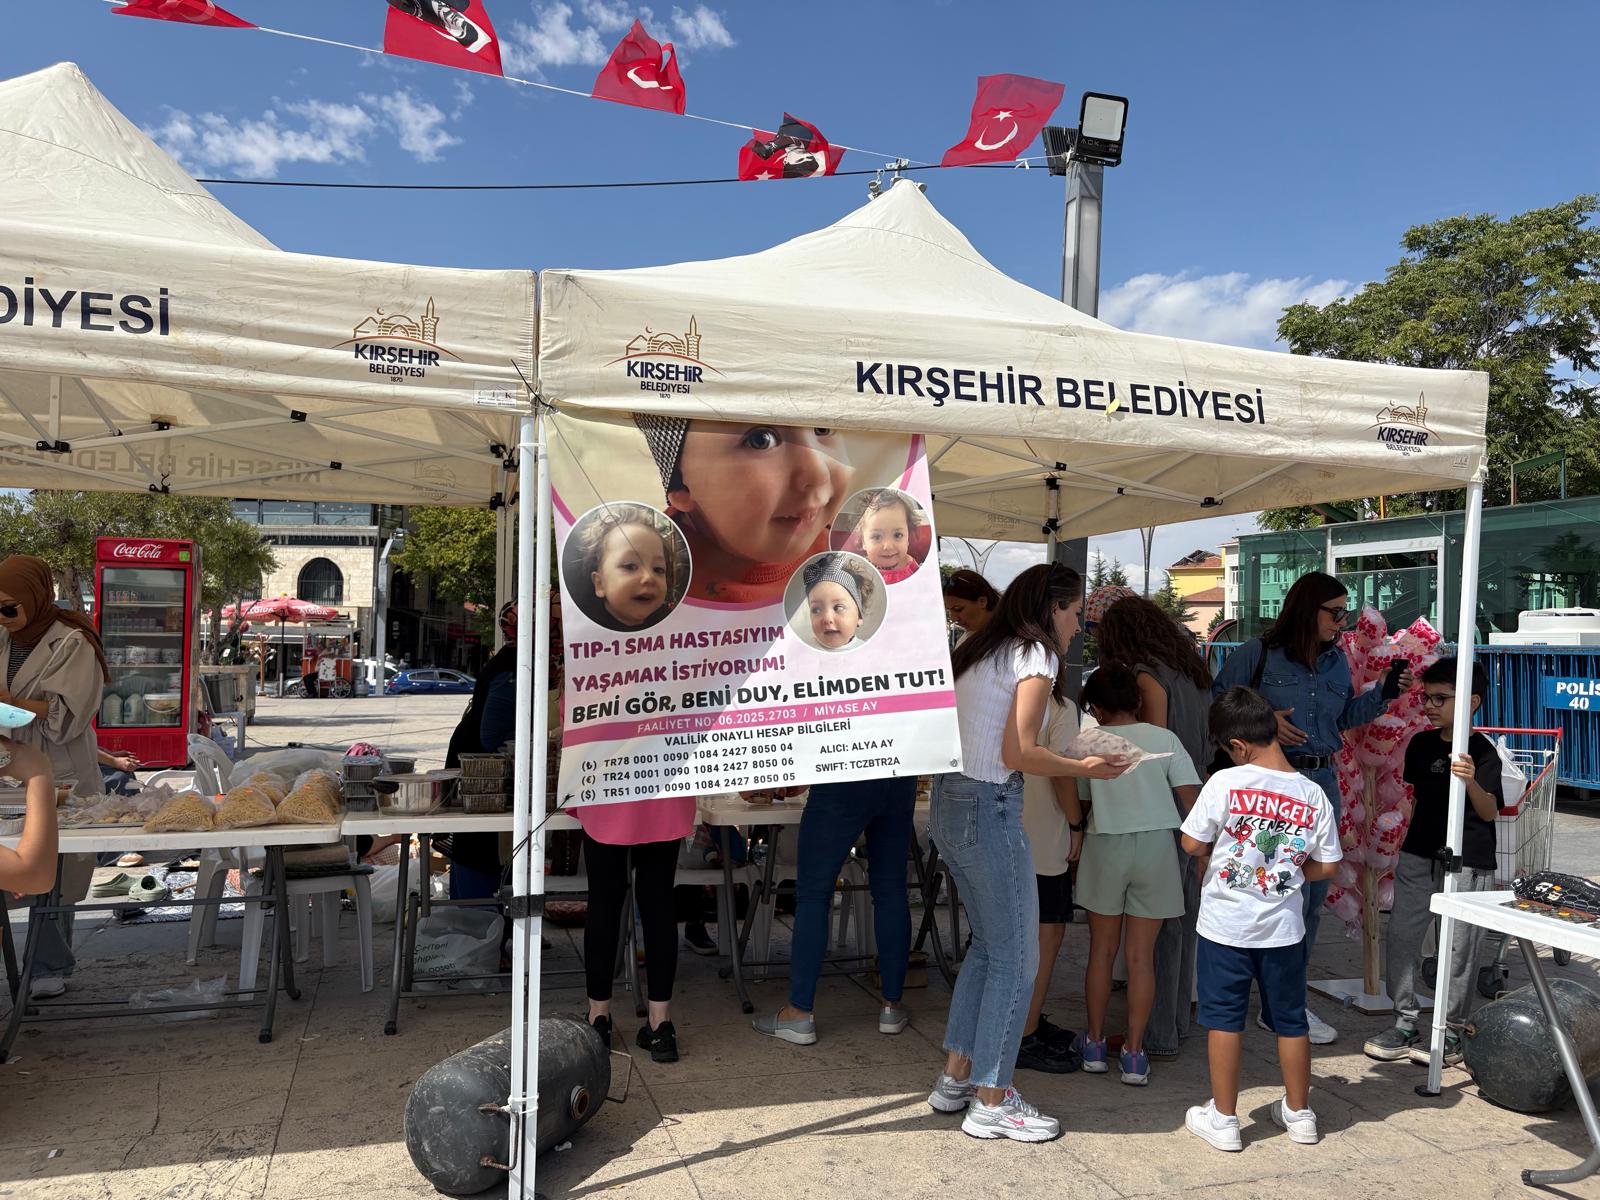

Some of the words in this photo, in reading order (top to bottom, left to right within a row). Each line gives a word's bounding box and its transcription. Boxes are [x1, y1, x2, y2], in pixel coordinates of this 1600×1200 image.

[856, 361, 1046, 408] KIRŞEHİR
[1056, 377, 1266, 425] BELEDİYESİ
[570, 640, 620, 659] TIP-1
[625, 635, 665, 655] SMA
[669, 625, 785, 649] HASTASIYIM
[572, 665, 667, 693] YAŞAMAK
[672, 655, 786, 681] İSTİYORUM!
[572, 695, 620, 724] BENİ
[625, 691, 676, 714] GÖR,
[681, 684, 732, 709] BENİ
[737, 684, 789, 704] DUY,
[793, 675, 890, 699] ELİMDEN
[894, 668, 946, 689] TUT!
[1568, 697, 1590, 710] 40
[637, 716, 690, 734] FAALİYET
[695, 716, 716, 728] NO:
[718, 708, 796, 726] 06.2025.2703
[814, 702, 860, 717] MİYASE
[861, 701, 879, 712] AY
[664, 732, 708, 747] VALİLİK
[712, 729, 753, 743] ONAYLI
[756, 727, 794, 739] HESAP
[797, 718, 851, 735] BİLGİLERİ
[820, 743, 849, 754] ALICI:
[852, 740, 878, 751] ALYA
[880, 738, 894, 748] AY
[604, 756, 630, 768] TR78
[633, 754, 659, 764] 0001
[663, 751, 690, 762] 0090
[694, 748, 718, 760] 1084
[722, 746, 747, 757] 2427
[751, 744, 777, 755] 8050
[780, 743, 793, 753] 04
[815, 761, 848, 773] SWIFT:
[849, 756, 901, 769] TCZBTR2A
[603, 771, 630, 782] TR24
[634, 769, 659, 779] 0001
[664, 766, 690, 777] 0090
[694, 764, 719, 775] 1084
[723, 761, 748, 772] 2427
[752, 758, 778, 769] 8050
[781, 757, 795, 767] 06
[603, 787, 630, 798] TR51
[634, 784, 660, 795] 0001
[664, 781, 691, 792] 0090
[695, 779, 720, 790] 1084
[724, 776, 750, 787] 2427
[753, 774, 779, 784] 8050
[782, 772, 796, 782] 05
